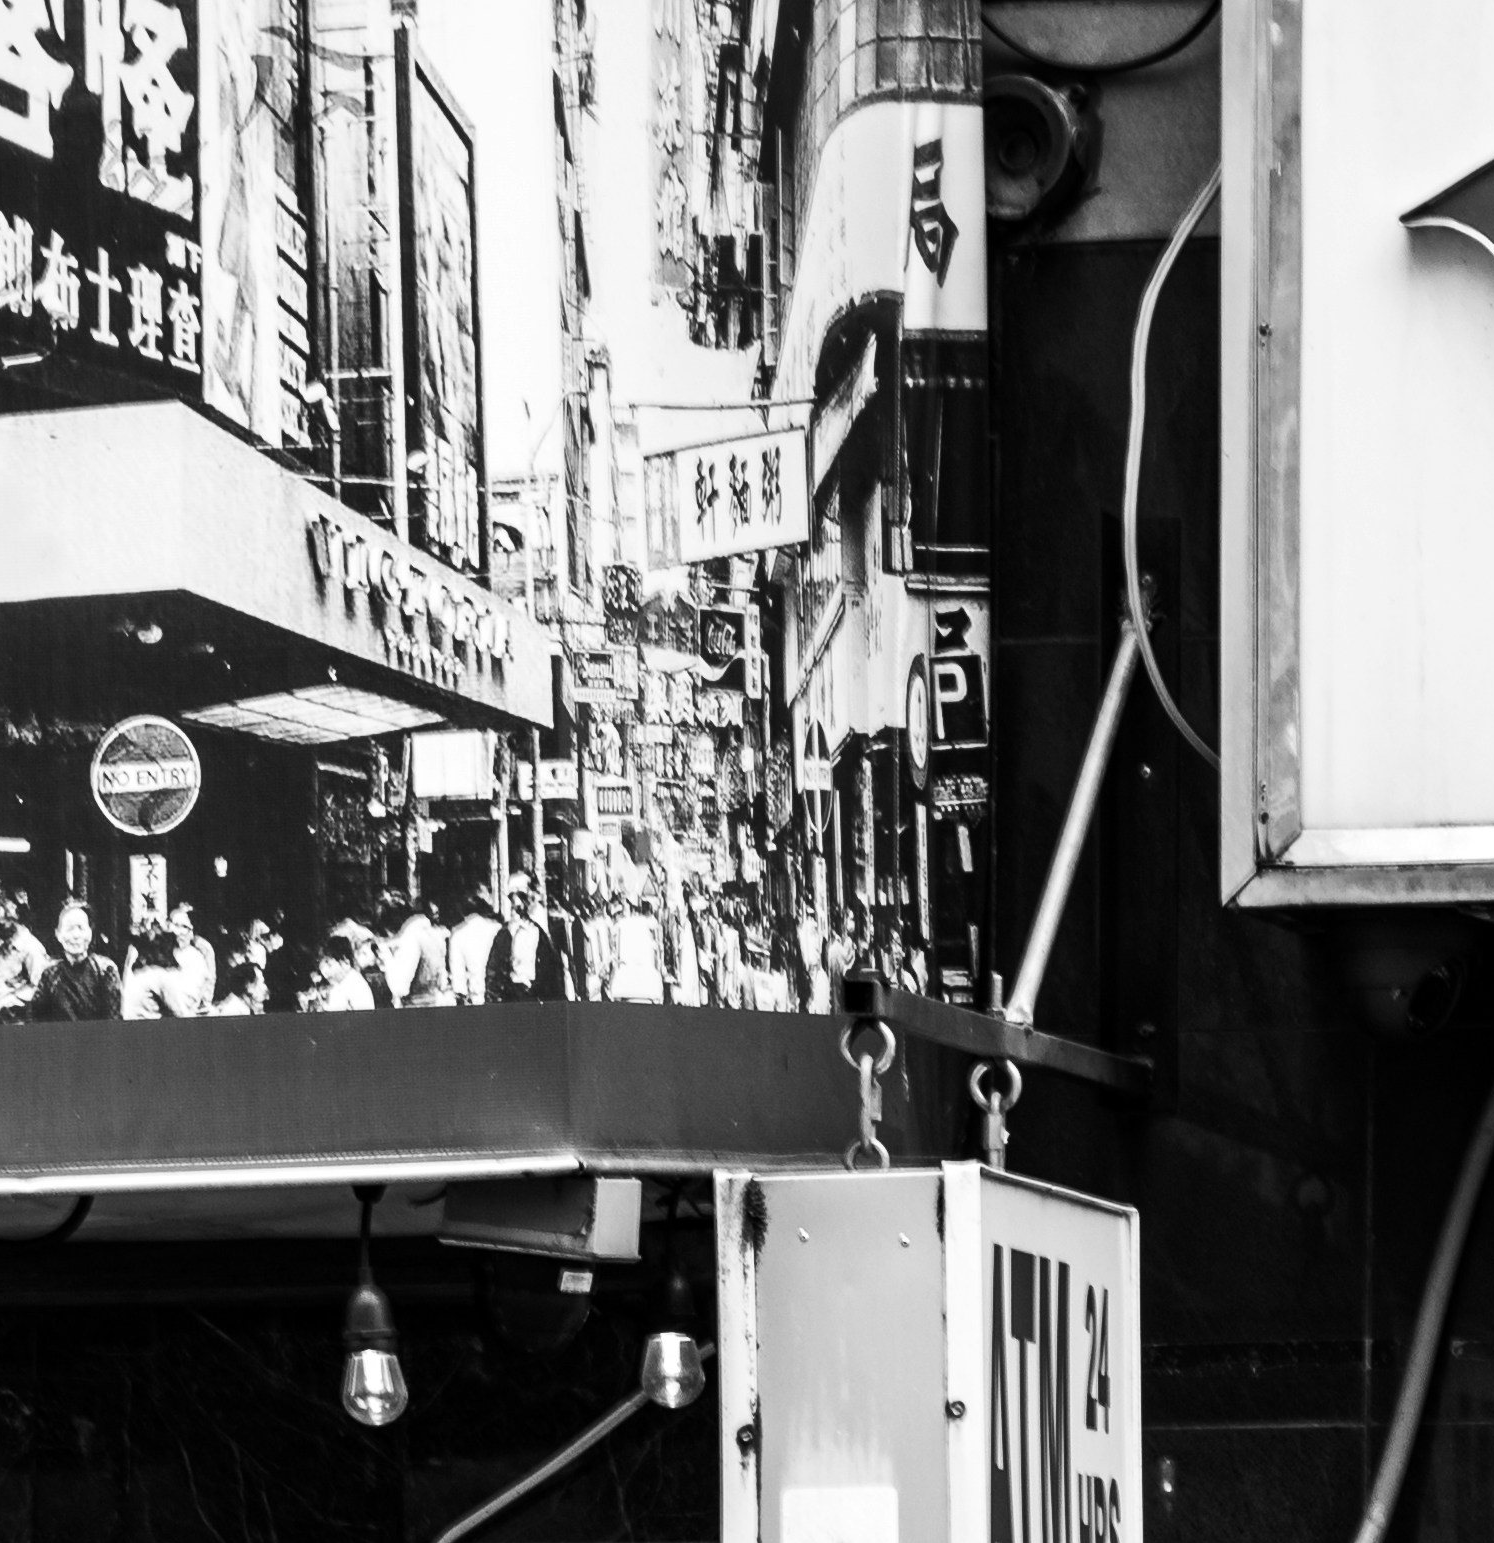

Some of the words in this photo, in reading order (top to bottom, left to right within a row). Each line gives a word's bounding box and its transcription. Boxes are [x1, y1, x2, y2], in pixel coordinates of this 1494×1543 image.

[935, 662, 969, 741] P
[102, 770, 130, 788] NO
[136, 768, 190, 786] ENTRY
[1085, 1284, 1111, 1436] 24
